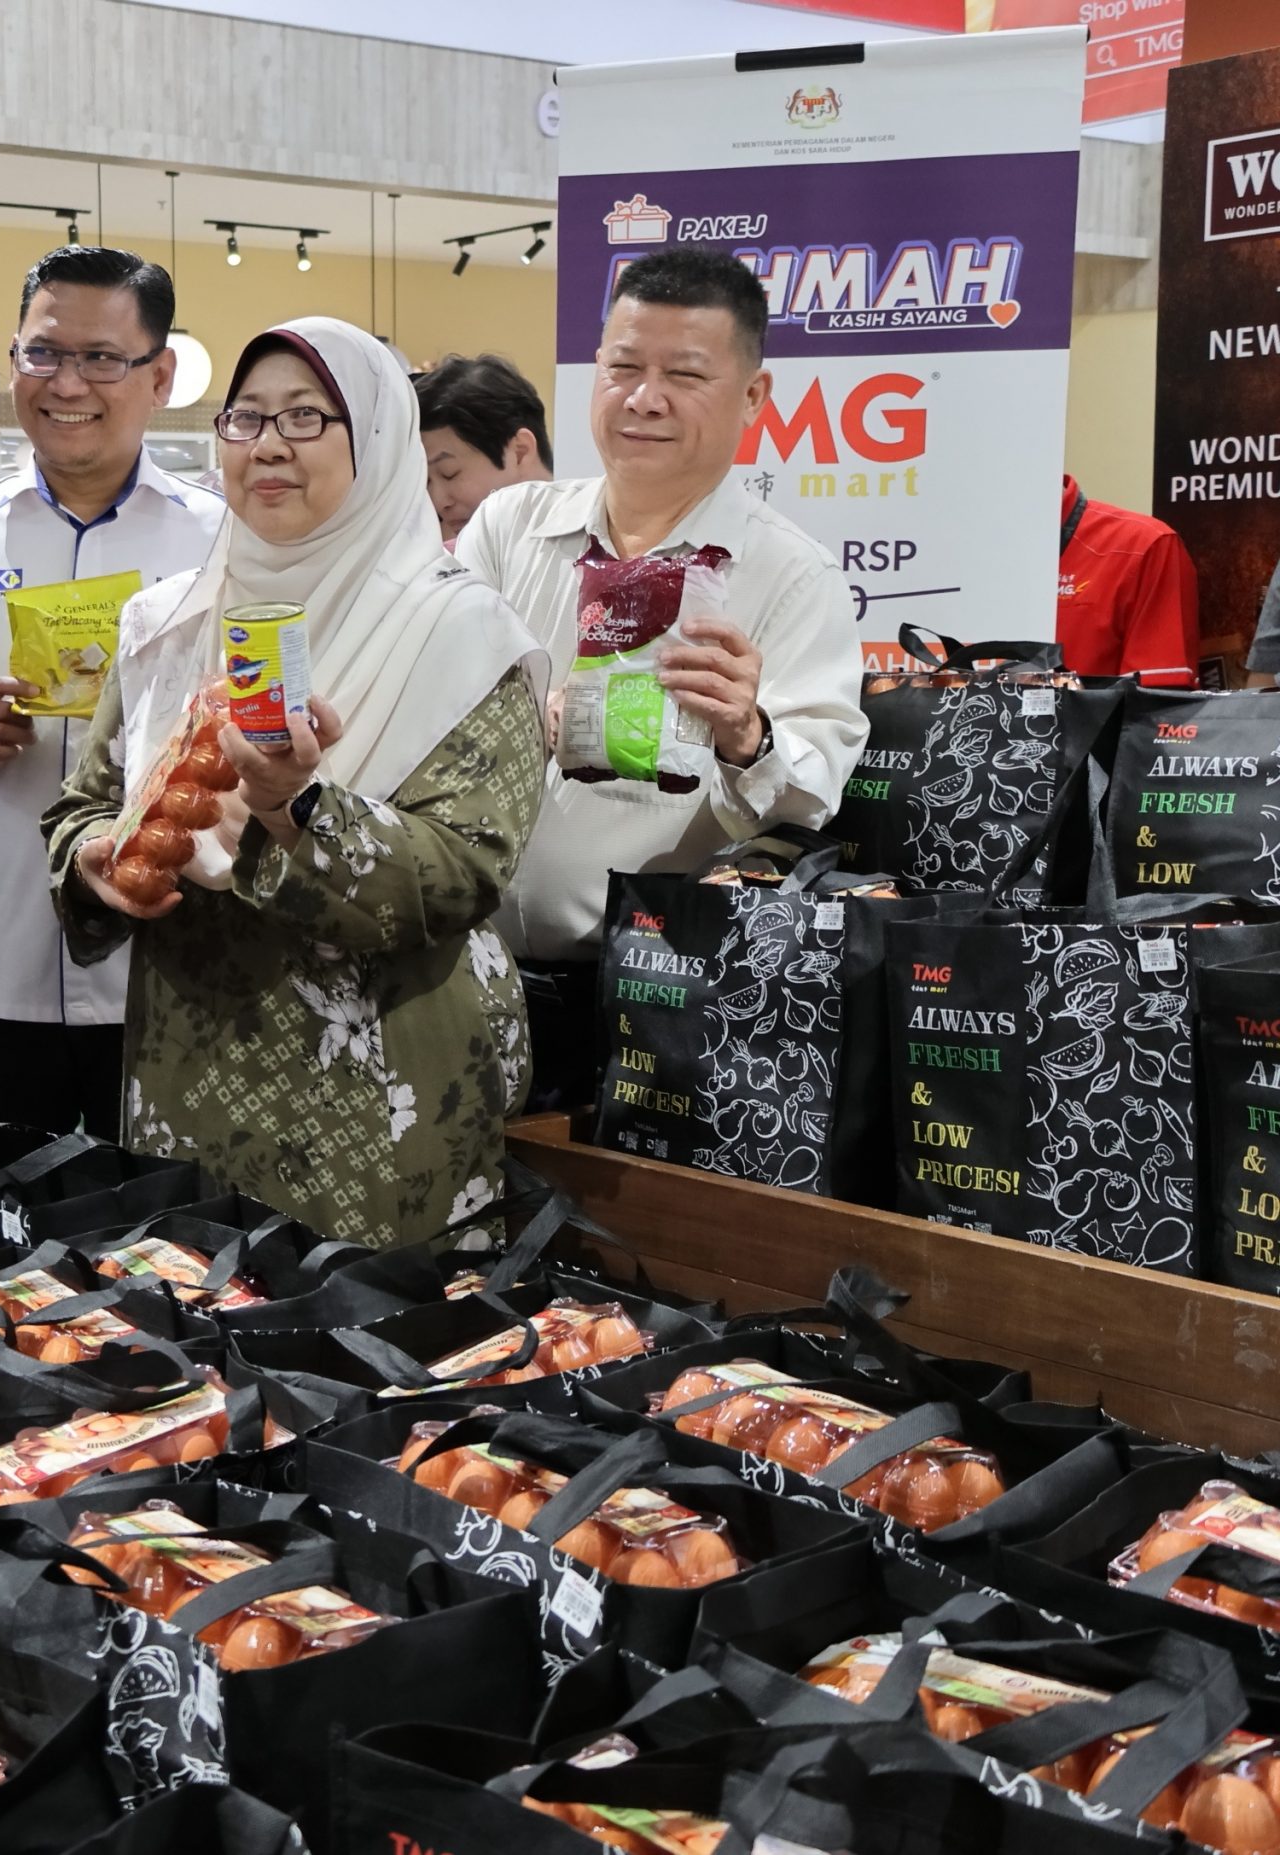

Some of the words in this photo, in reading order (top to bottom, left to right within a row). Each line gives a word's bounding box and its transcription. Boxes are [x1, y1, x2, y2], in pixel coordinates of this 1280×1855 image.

[1079, 1, 1127, 24] Shop
[678, 216, 767, 240] PAKEJ
[829, 310, 885, 329] KASIH
[889, 308, 968, 327] SAYANG
[732, 373, 927, 465] MG
[799, 466, 919, 498] mart
[843, 540, 917, 572] RSP
[1157, 723, 1199, 738] TMG
[858, 750, 914, 770] WAYS
[1147, 756, 1260, 778] ALWAYS
[1139, 792, 1238, 814] FRESH
[1136, 825, 1157, 848] &
[1137, 862, 1197, 885] LOW
[633, 911, 665, 931] TMG
[621, 947, 708, 978] ALWAYS
[913, 964, 953, 984] TMG
[616, 978, 688, 1009] FRESH
[620, 1013, 633, 1036] &
[908, 1005, 1016, 1036] ALWAYS
[621, 1047, 656, 1075] LOW
[908, 1042, 1002, 1073] FRESH
[613, 1079, 691, 1118] PRICES!
[911, 1081, 933, 1106] &
[913, 1120, 974, 1149] LOW
[1242, 1146, 1267, 1175] &
[916, 1158, 1021, 1196] PRICES!
